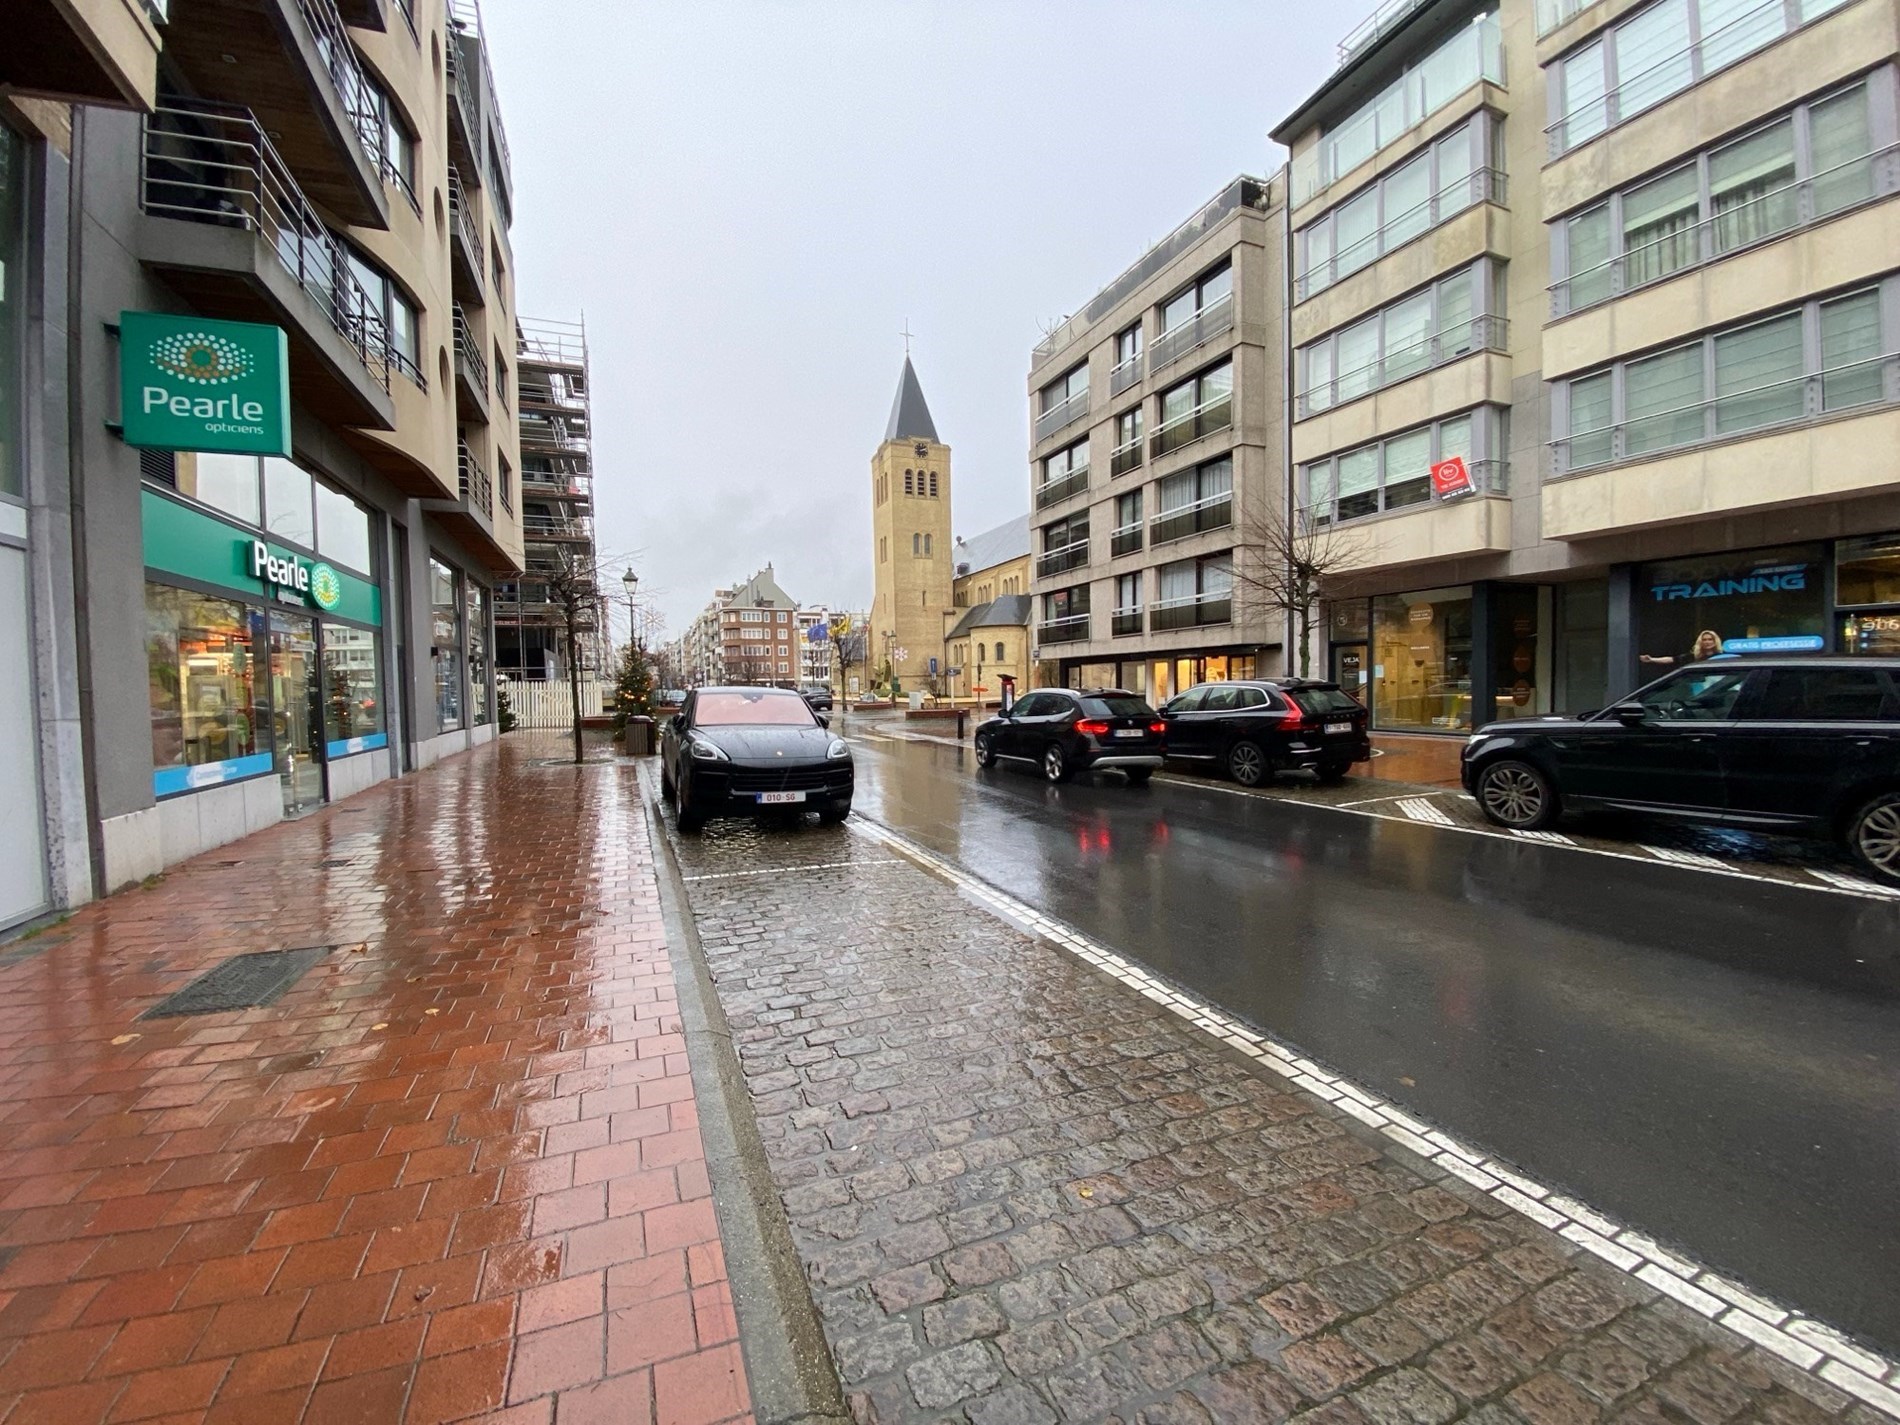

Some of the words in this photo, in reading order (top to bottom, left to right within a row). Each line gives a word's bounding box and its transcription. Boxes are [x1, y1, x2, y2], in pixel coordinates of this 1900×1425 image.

[143, 386, 263, 421] Pearle
[205, 422, 264, 435] opticiens
[254, 540, 309, 592] Pearle
[1650, 573, 1805, 600] TRAINING
